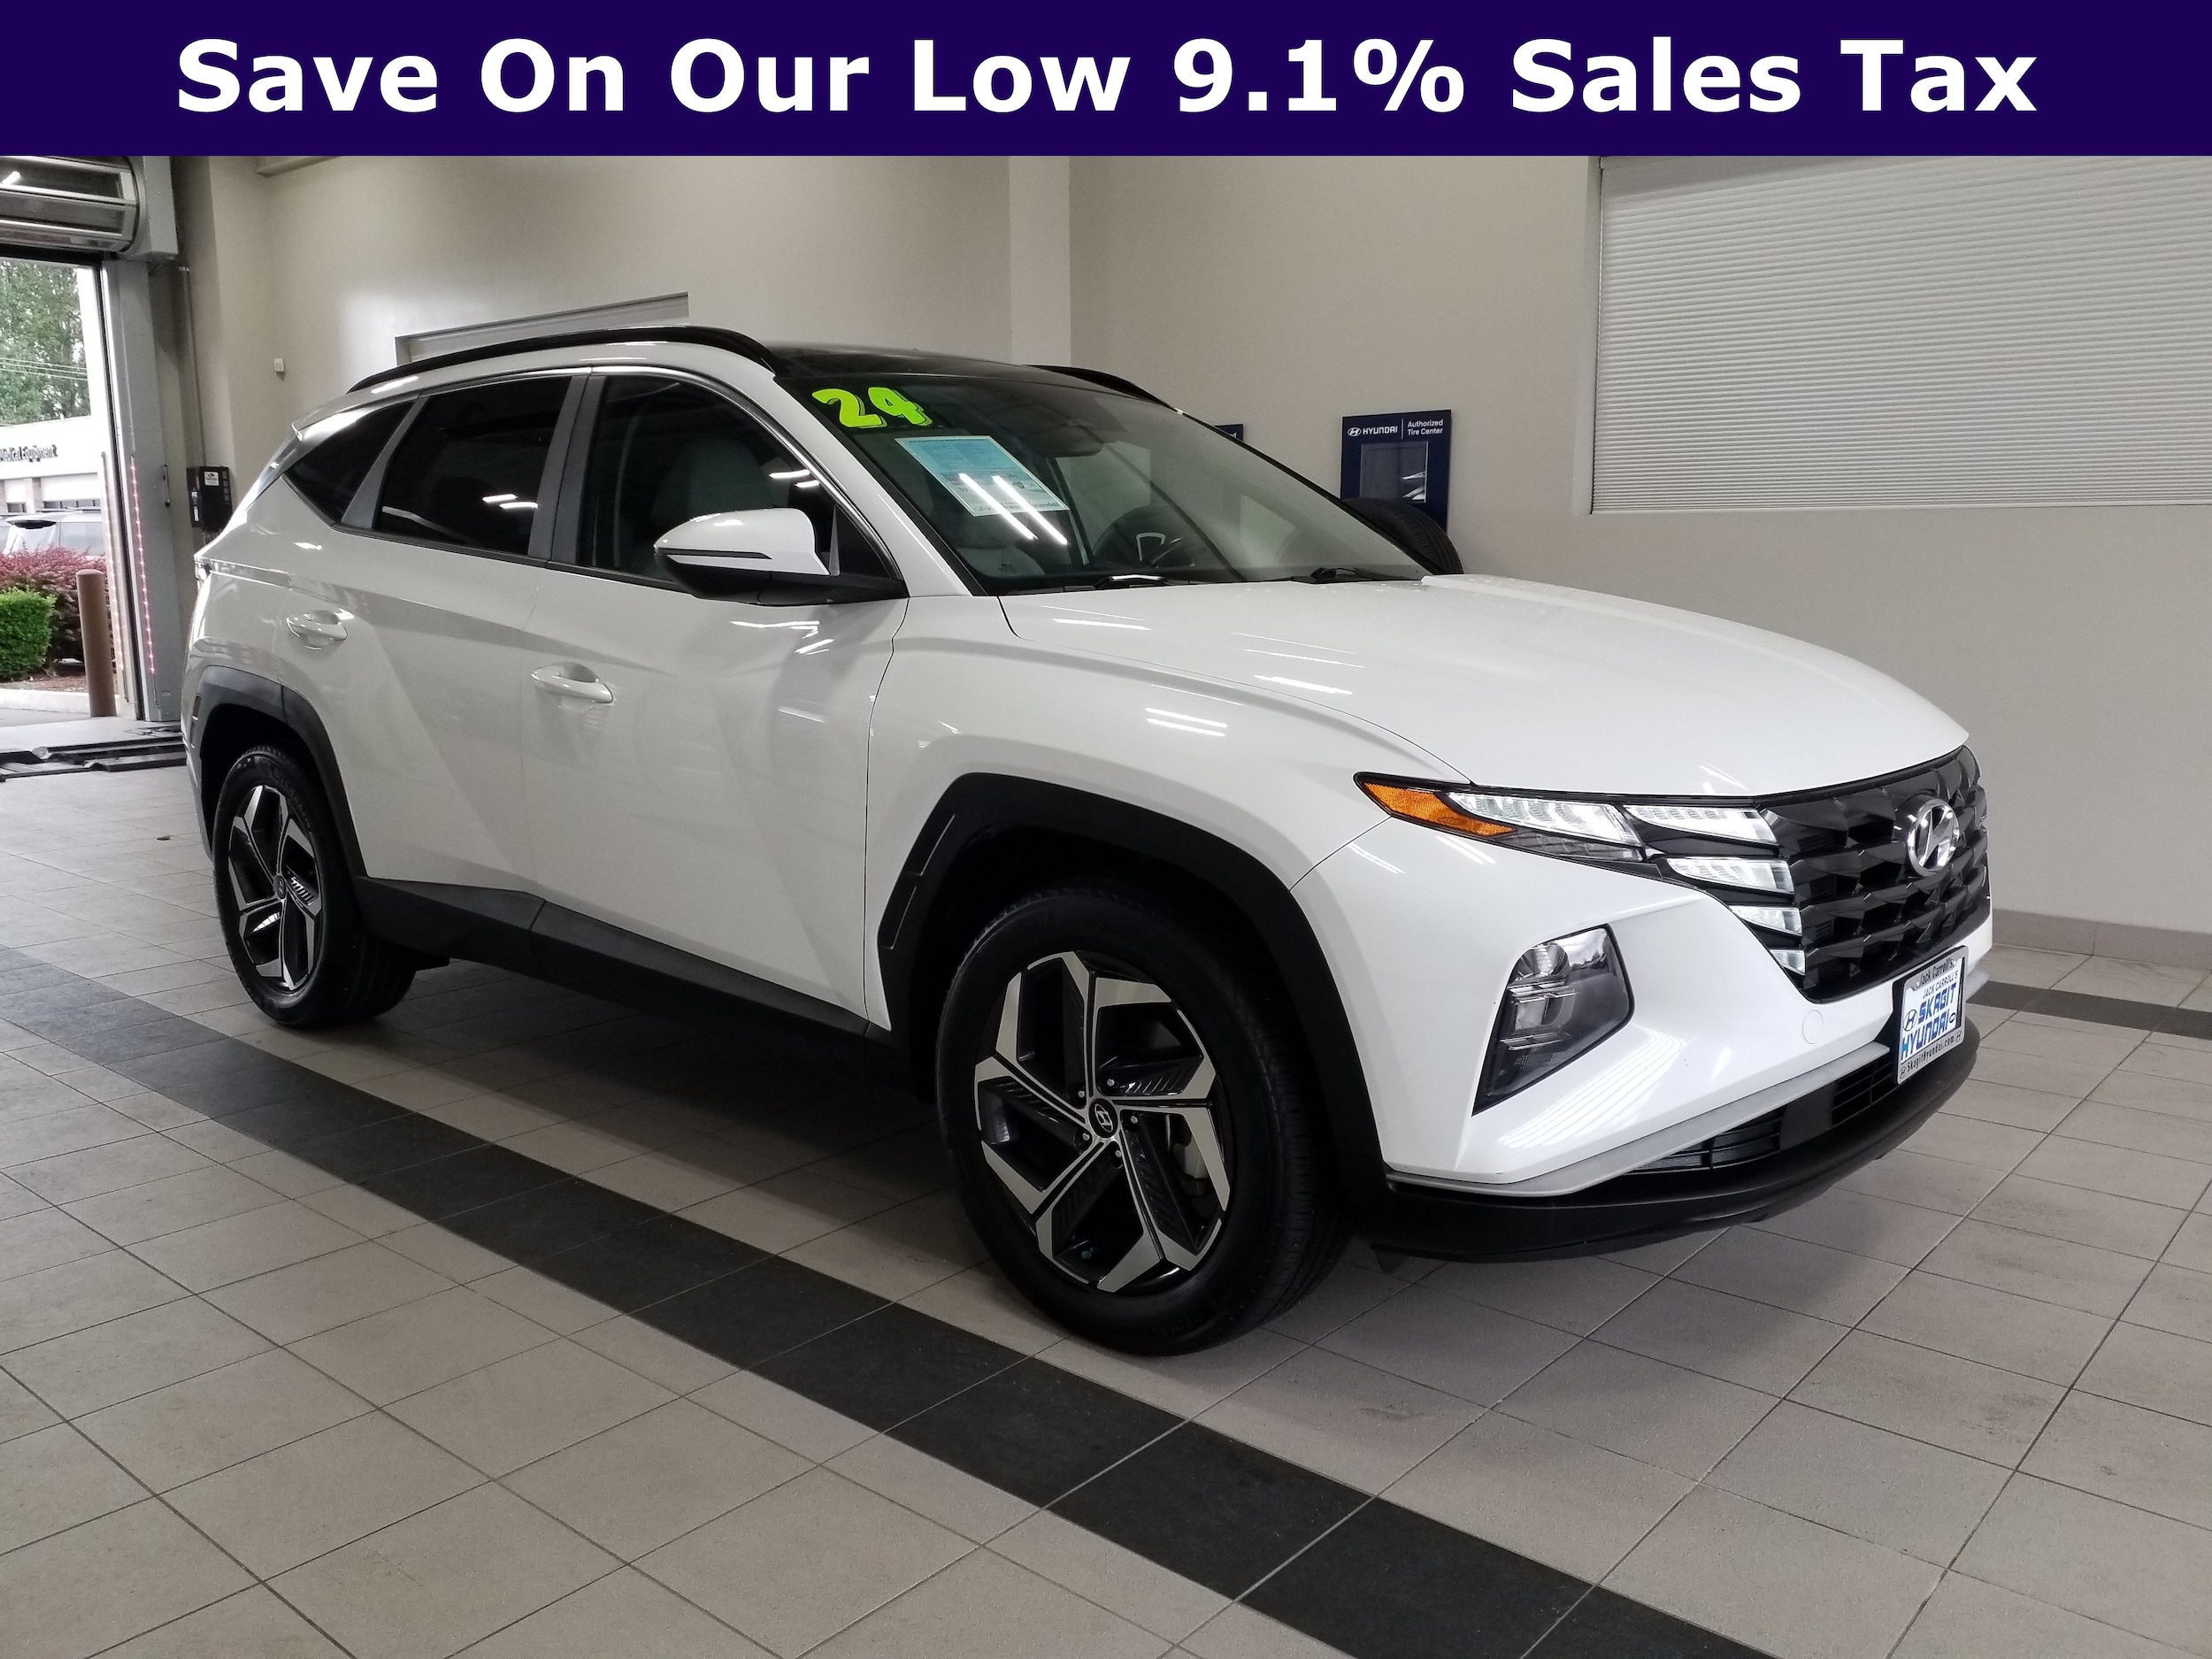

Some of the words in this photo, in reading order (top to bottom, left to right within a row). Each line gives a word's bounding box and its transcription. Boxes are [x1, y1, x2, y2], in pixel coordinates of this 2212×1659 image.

[811, 386, 933, 429] 24
[1407, 419, 1444, 427] Authorized
[1363, 426, 1398, 435] HYUNDAI
[1923, 983, 1935, 1000] JACK
[1935, 970, 1959, 991] CARROLL'S
[1918, 982, 1957, 1025] SKAGIT
[1901, 1009, 1950, 1061] HYUNDAI
